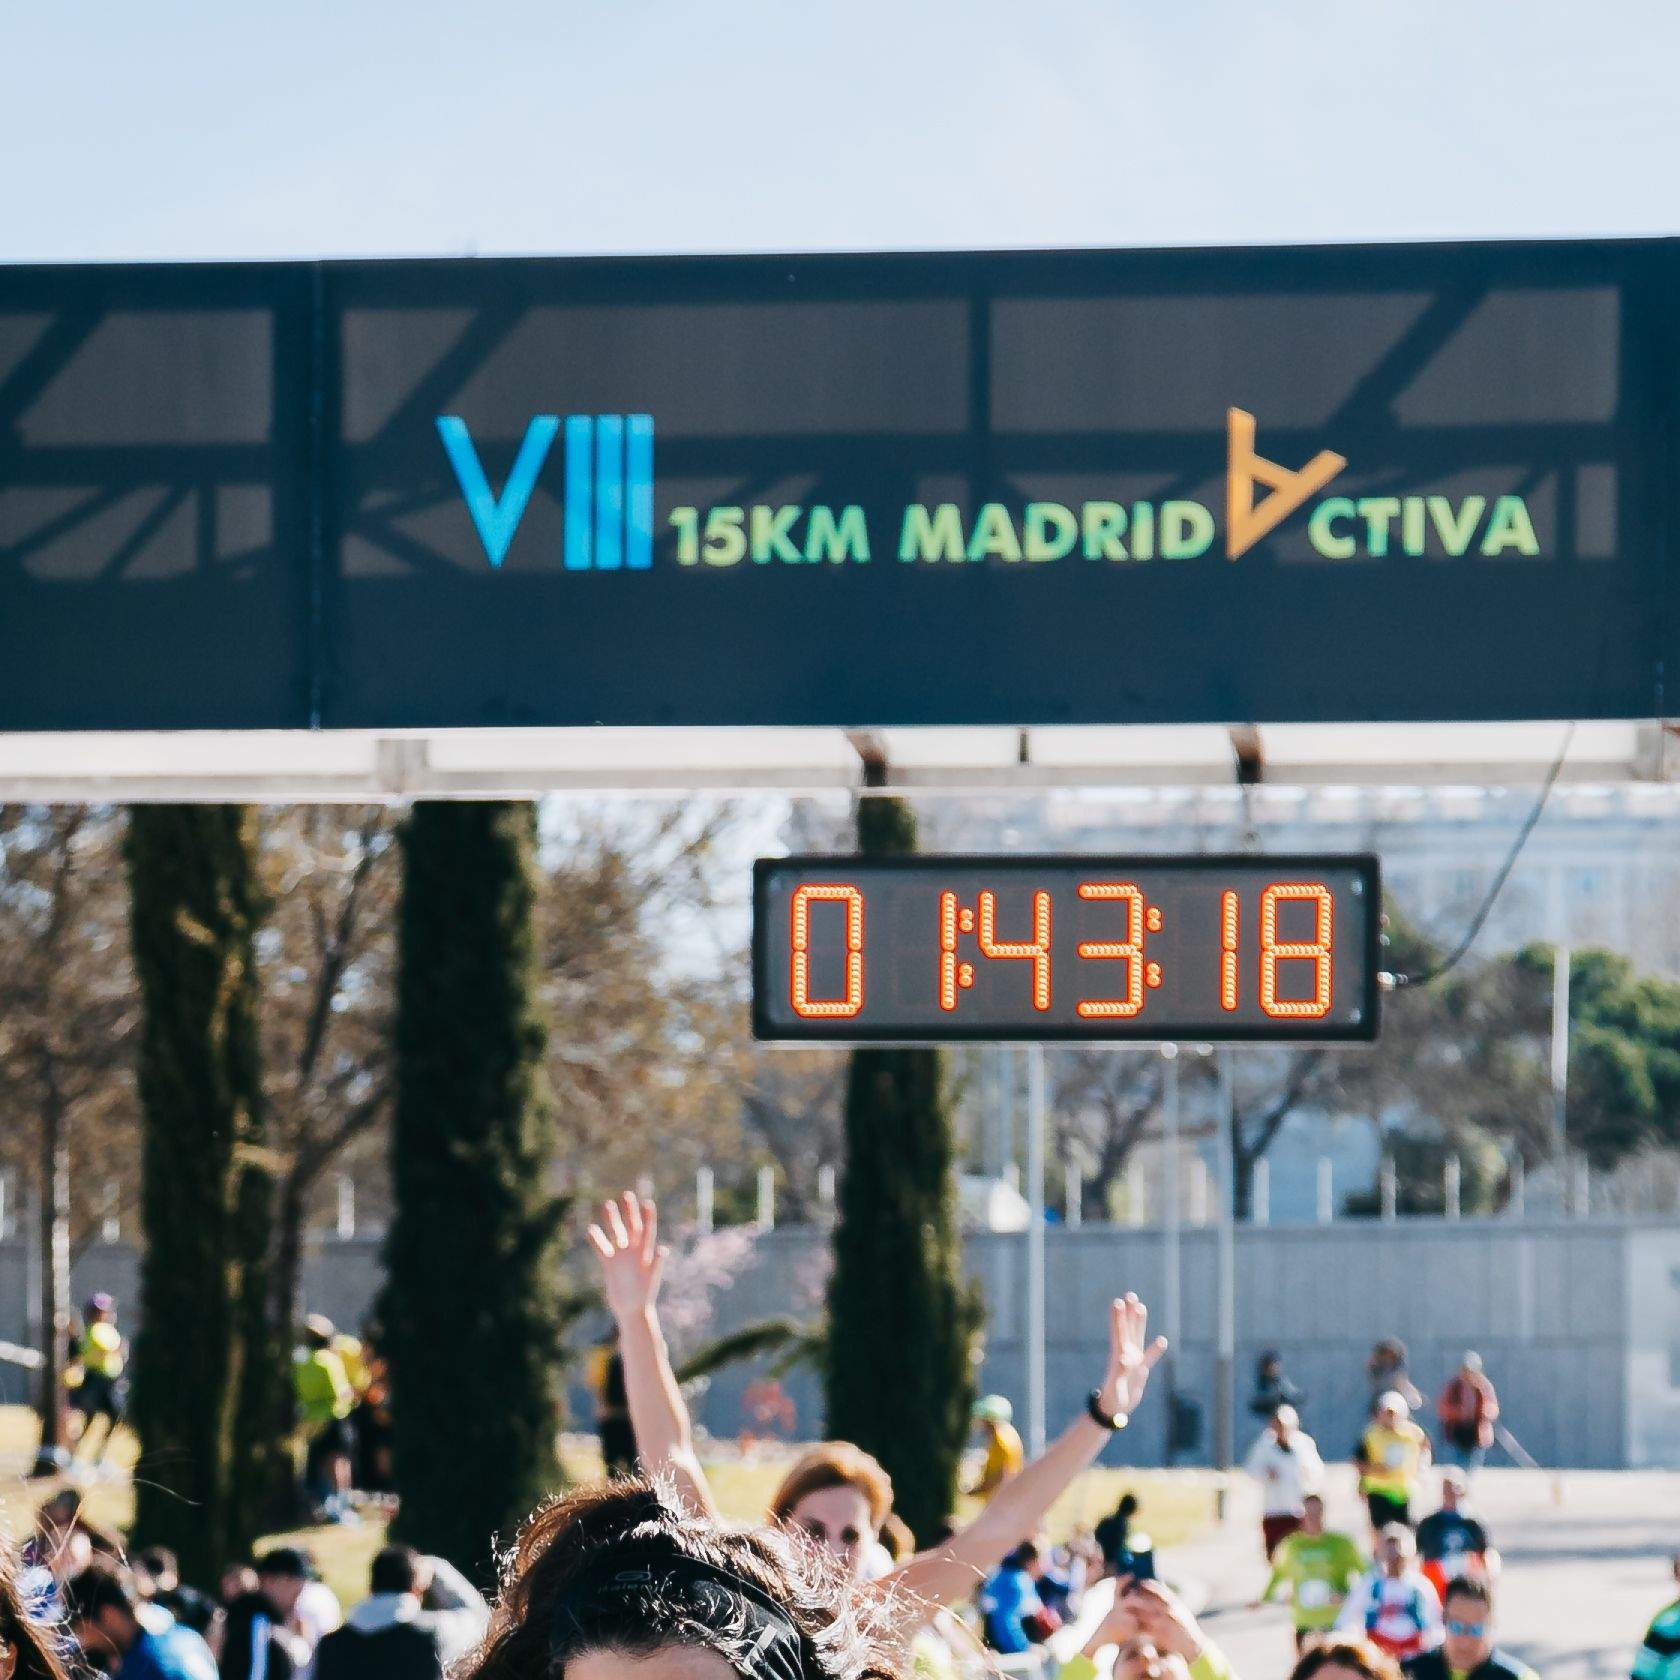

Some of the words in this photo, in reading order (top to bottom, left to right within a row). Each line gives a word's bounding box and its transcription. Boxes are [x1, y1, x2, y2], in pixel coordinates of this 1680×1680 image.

[436, 411, 655, 571] VIII
[668, 503, 870, 568] 15KM
[897, 499, 1216, 563] MADRID
